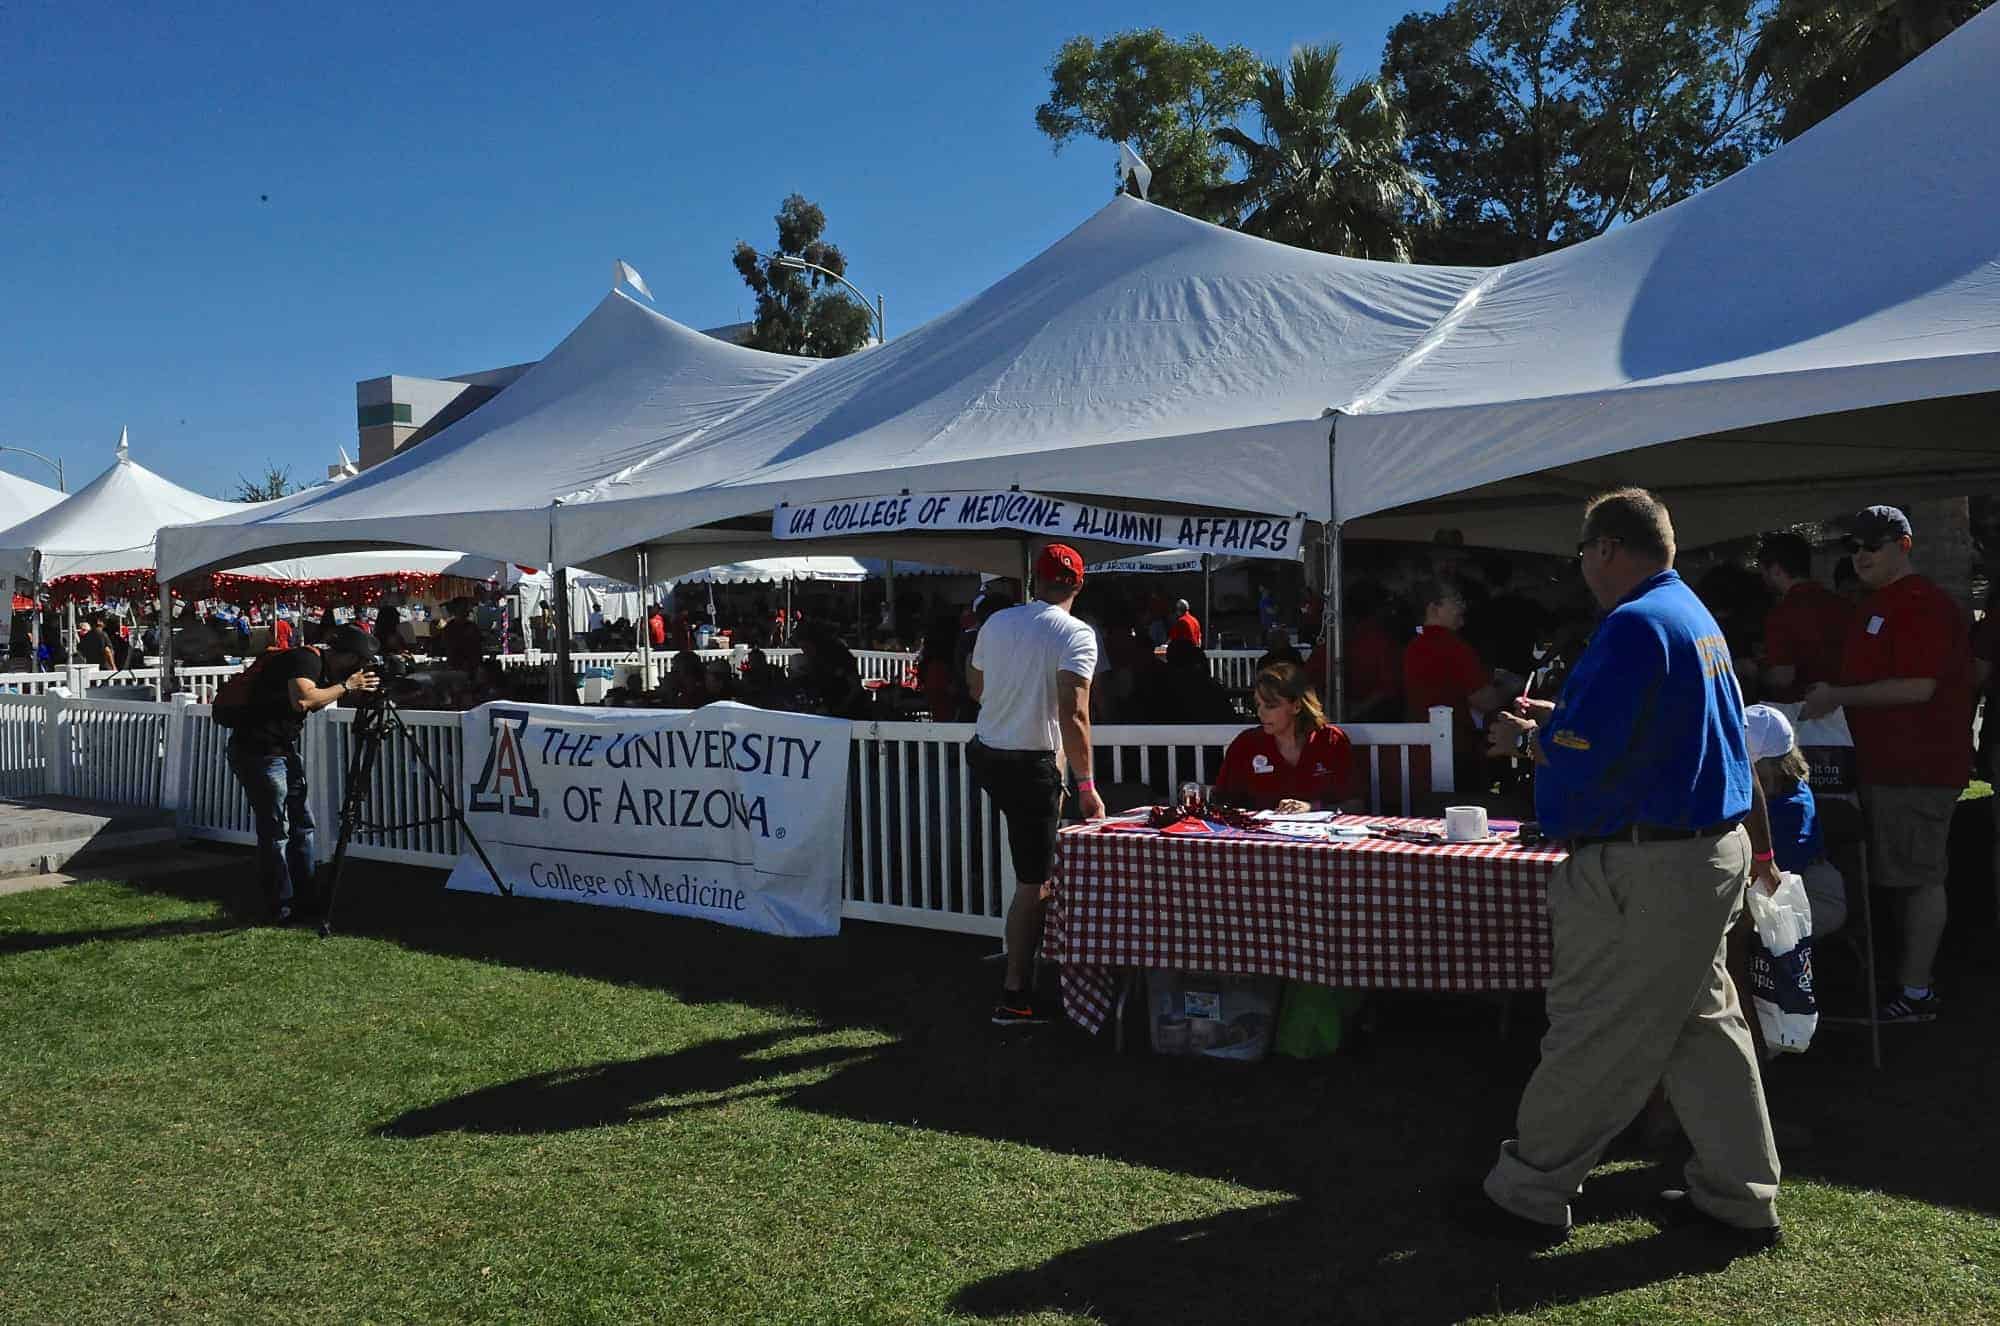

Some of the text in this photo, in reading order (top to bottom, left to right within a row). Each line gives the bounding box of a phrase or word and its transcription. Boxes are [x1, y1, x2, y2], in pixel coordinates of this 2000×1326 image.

[789, 494, 1291, 552] UA COLLEGE OF MEDICINE ALUMNI AFFAIRS
[542, 727, 822, 780] THE UNIVERSITY
[563, 779, 771, 838] OF ARIZONA
[530, 863, 746, 911] College of Medicine
